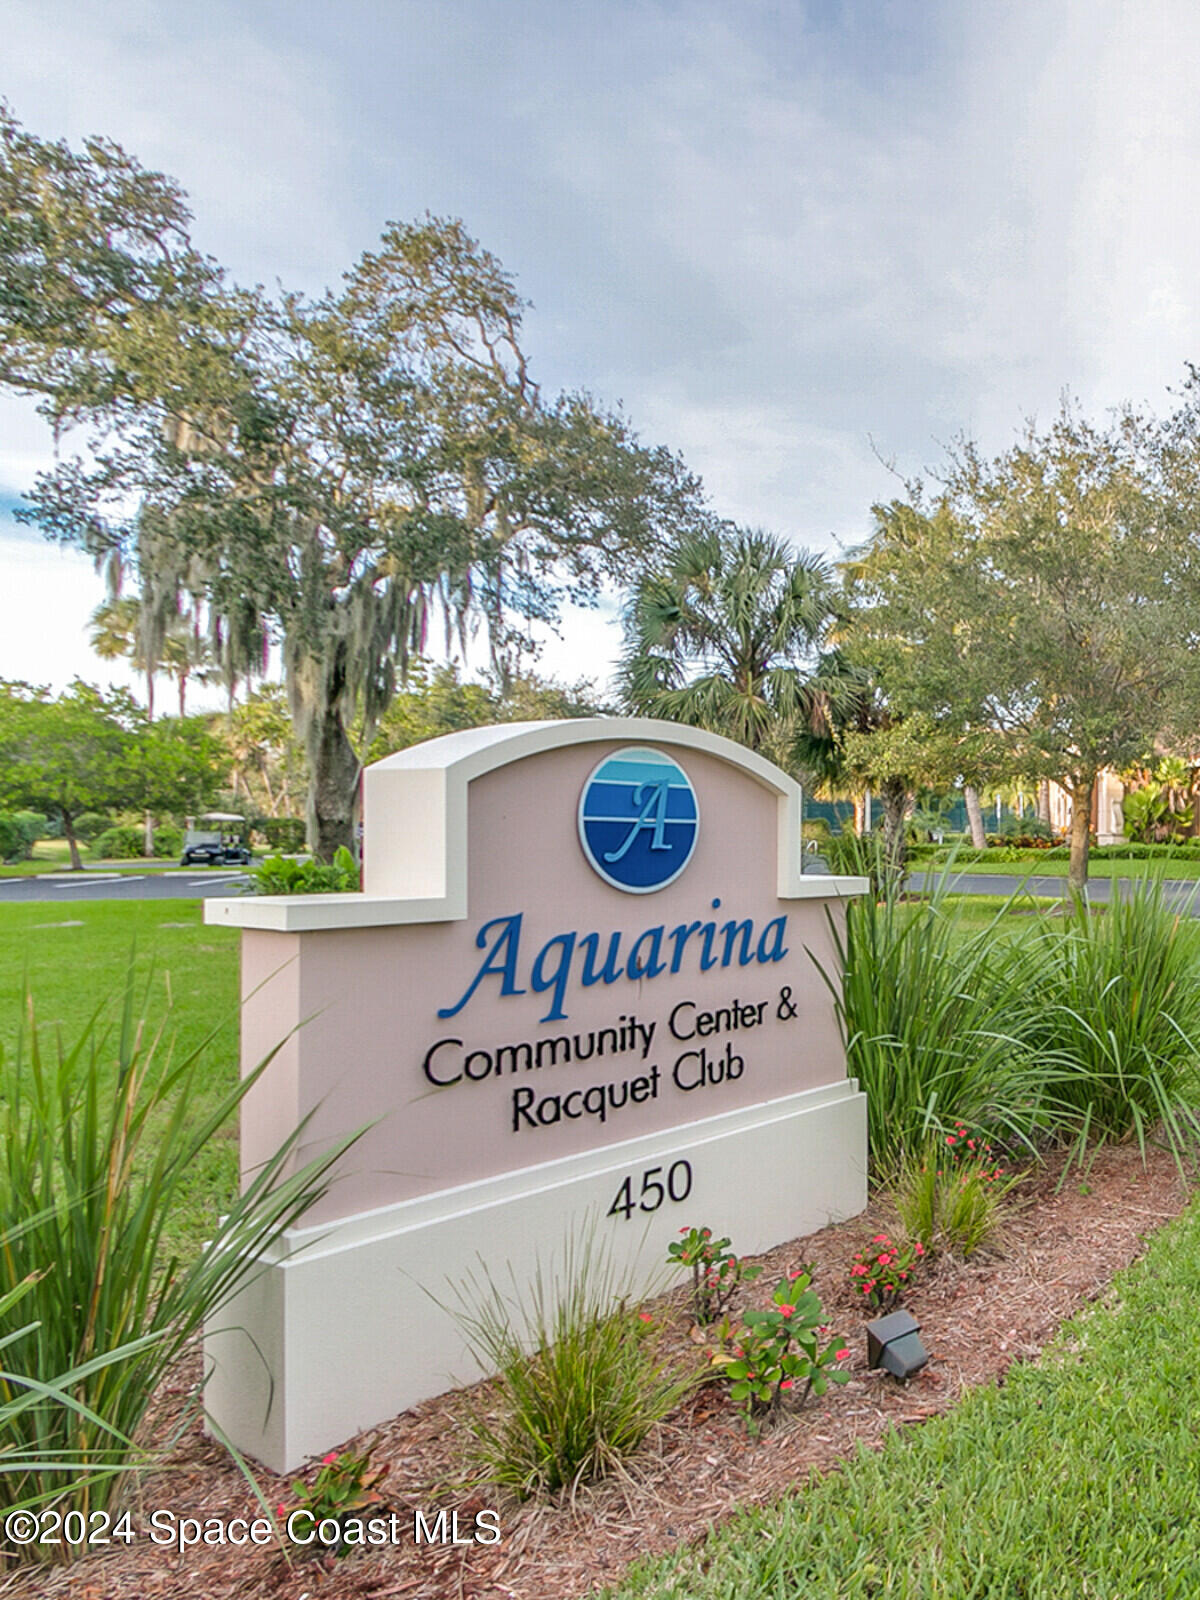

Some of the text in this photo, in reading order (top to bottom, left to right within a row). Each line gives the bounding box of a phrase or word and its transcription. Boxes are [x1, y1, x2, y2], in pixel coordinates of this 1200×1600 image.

[603, 777, 673, 863] A
[437, 898, 789, 1024] Aquarina
[423, 986, 799, 1087] Community Center &
[512, 1043, 745, 1133] Racquet Club
[606, 1159, 693, 1221] 450
